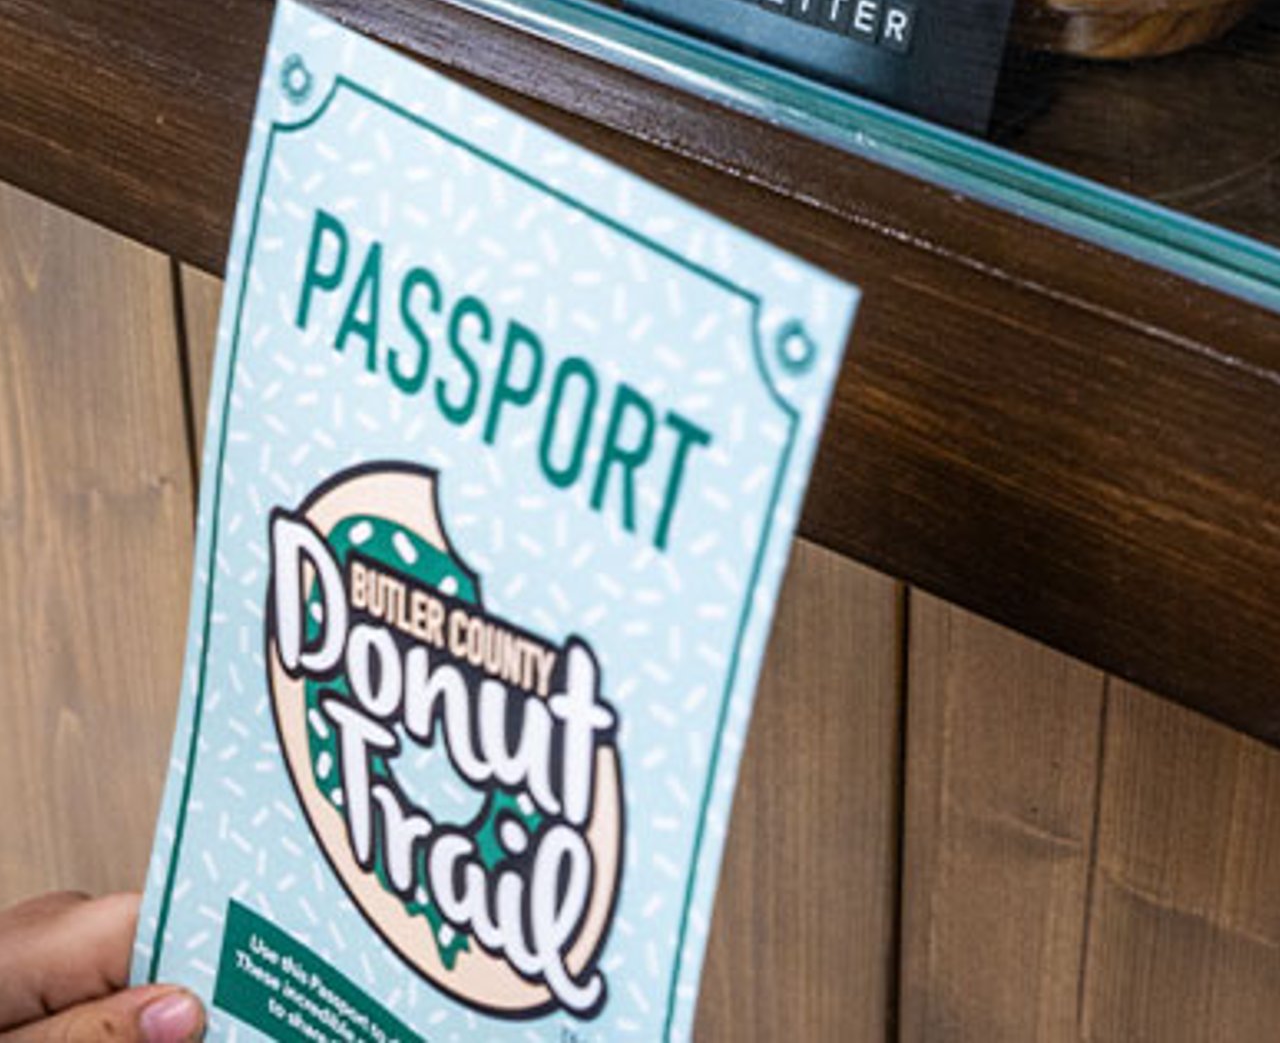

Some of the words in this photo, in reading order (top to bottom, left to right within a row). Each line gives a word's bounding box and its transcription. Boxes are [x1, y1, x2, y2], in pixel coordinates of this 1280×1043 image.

[295, 208, 712, 552] PASSPORT
[272, 516, 614, 825] Donut
[350, 560, 446, 649] BUTLER
[448, 609, 557, 698] COUNTY
[249, 933, 279, 965] Use
[281, 955, 307, 985] this
[322, 697, 603, 1011] Trail
[235, 949, 280, 991] These
